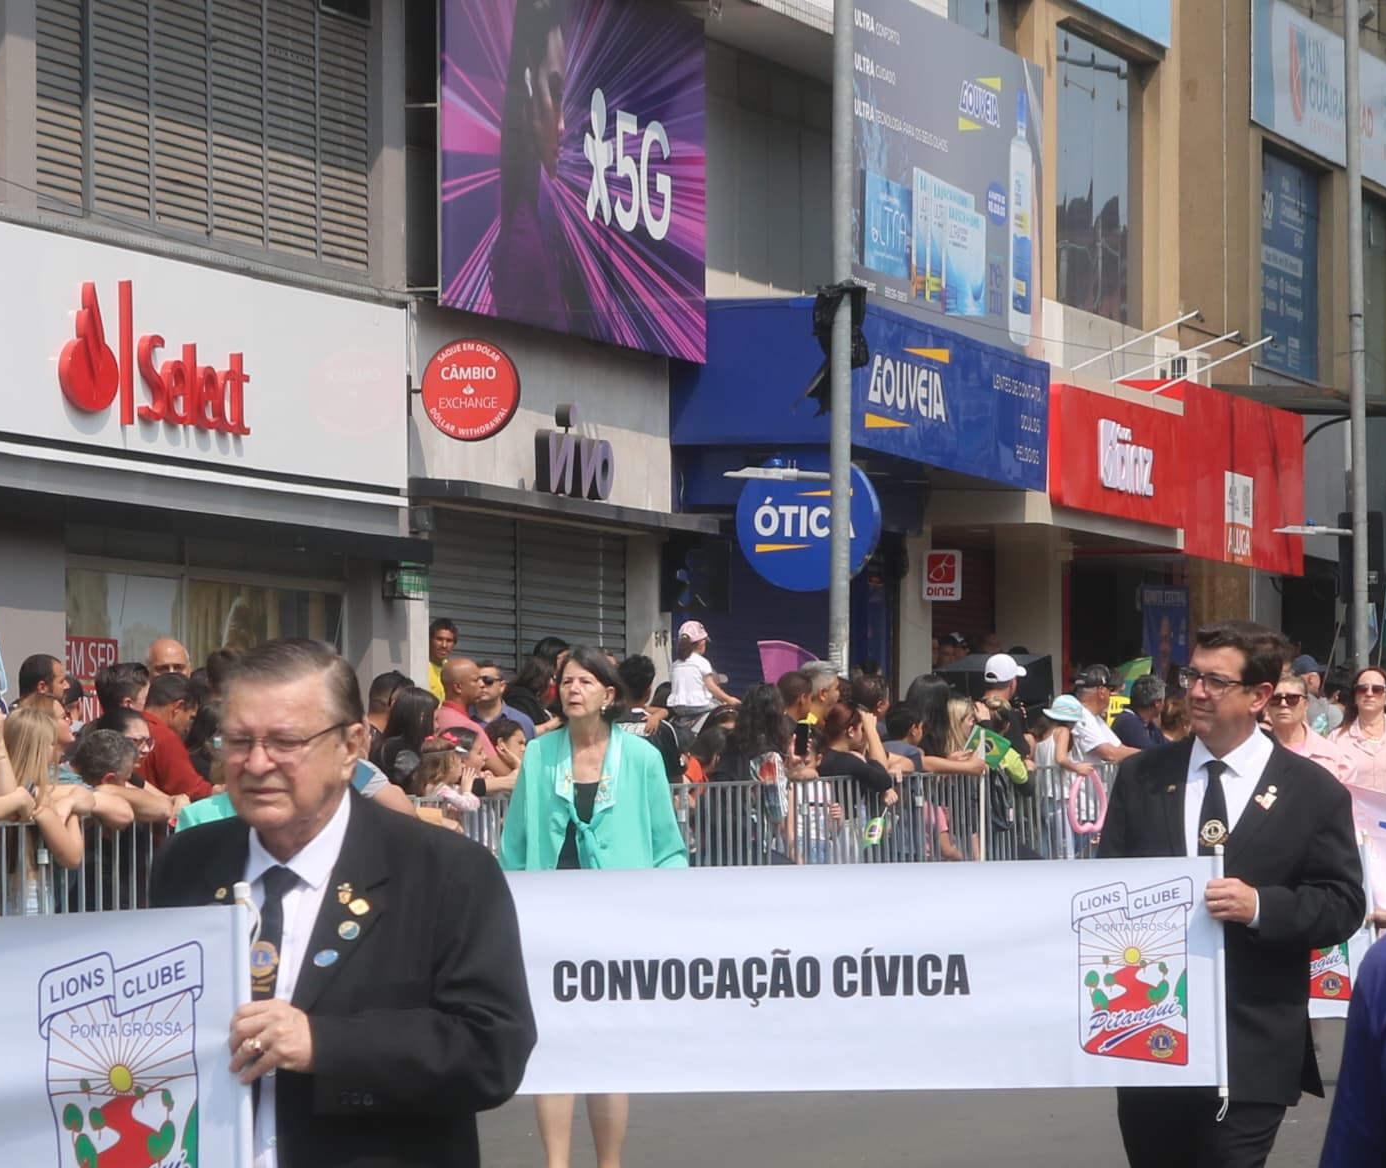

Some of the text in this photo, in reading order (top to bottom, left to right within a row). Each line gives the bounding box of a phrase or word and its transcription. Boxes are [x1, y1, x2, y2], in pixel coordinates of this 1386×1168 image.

[854, 8, 875, 34] ULTRA
[854, 52, 875, 78] ULTRA
[854, 96, 875, 123] ULTRA
[959, 80, 1001, 129] GOUVEIA
[614, 110, 671, 240] 5G
[437, 343, 461, 362] SAQUE
[462, 343, 474, 352] EM
[136, 334, 251, 435] Select
[440, 363, 496, 380] CÂMBIO
[868, 354, 946, 423] GOUVEIA
[439, 397, 498, 409] EXCHANGE
[429, 407, 508, 436] DOLLAR WITHDRAWAL
[754, 496, 855, 538] ÓTIC
[927, 587, 955, 596] DINIZ
[1080, 891, 1121, 912] LIONS
[1133, 887, 1181, 910] CLUBE
[1095, 922, 1177, 932] PONTA GROSSA
[50, 968, 105, 1004] LIONS
[122, 960, 187, 999] CLUBE
[552, 947, 971, 1007] CONVOCAÇÃO CÍVICA
[70, 1022, 183, 1038] PONTA GROSSA
[1088, 997, 1181, 1037] Pitangui
